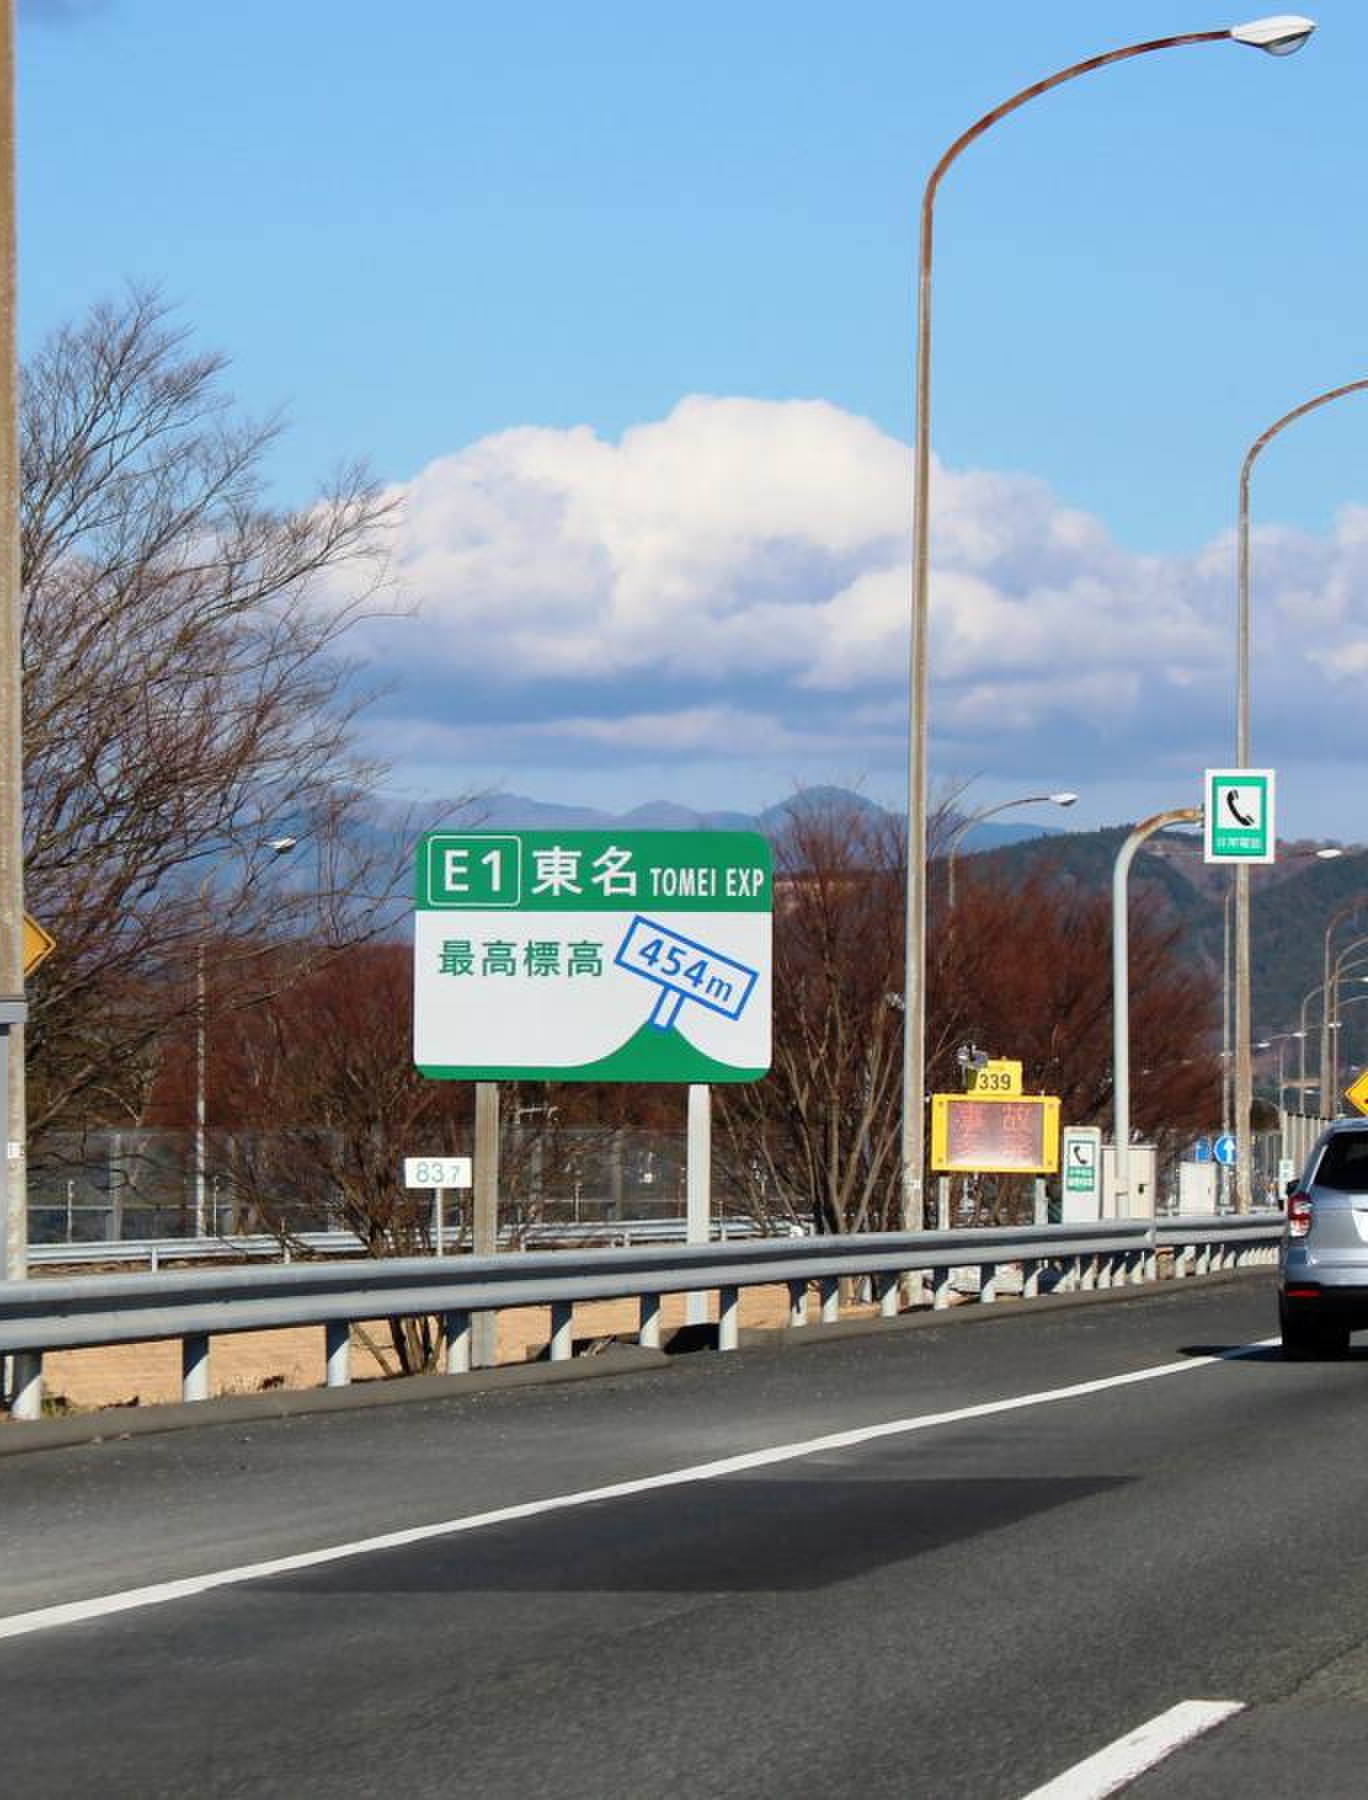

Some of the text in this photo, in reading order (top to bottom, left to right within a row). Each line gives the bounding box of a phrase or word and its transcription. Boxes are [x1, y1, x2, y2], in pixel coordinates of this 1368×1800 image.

[443, 849, 502, 892] E1
[531, 845, 637, 897] 東名
[649, 867, 765, 897] TOMEI EXP
[438, 939, 604, 978] 最高標高
[639, 936, 734, 1003] 454m
[978, 1073, 1012, 1091] 339
